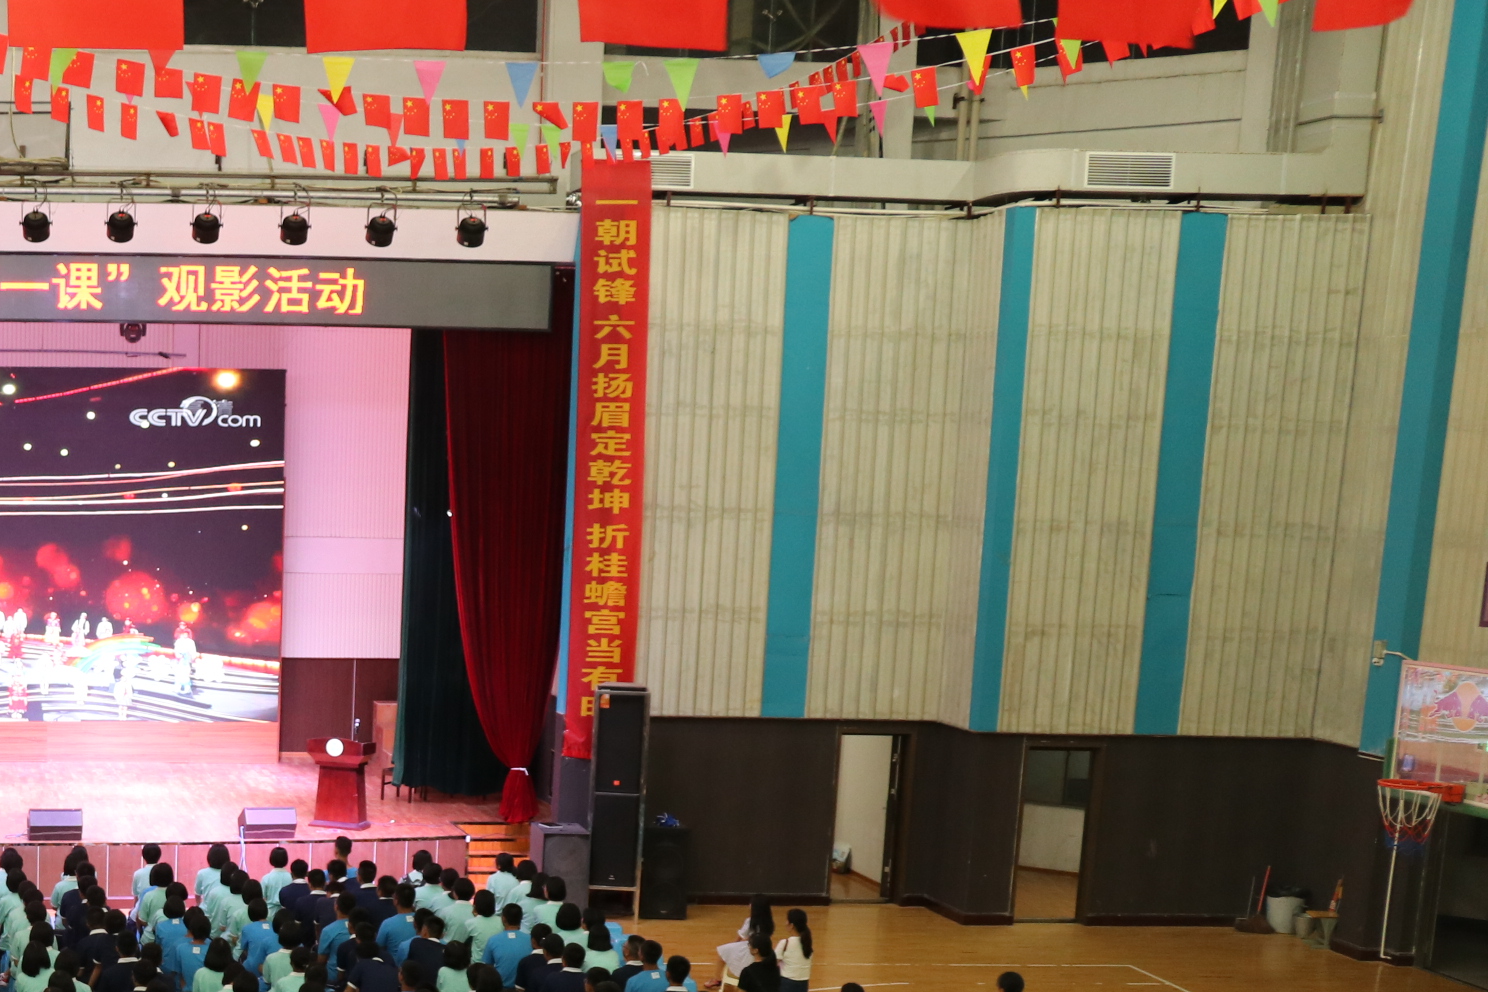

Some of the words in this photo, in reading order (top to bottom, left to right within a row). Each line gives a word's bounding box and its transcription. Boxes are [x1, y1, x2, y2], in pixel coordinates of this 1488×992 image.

[593, 199, 639, 305] 一朝试锋
[587, 314, 636, 515] 六月扬眉定乾坤
